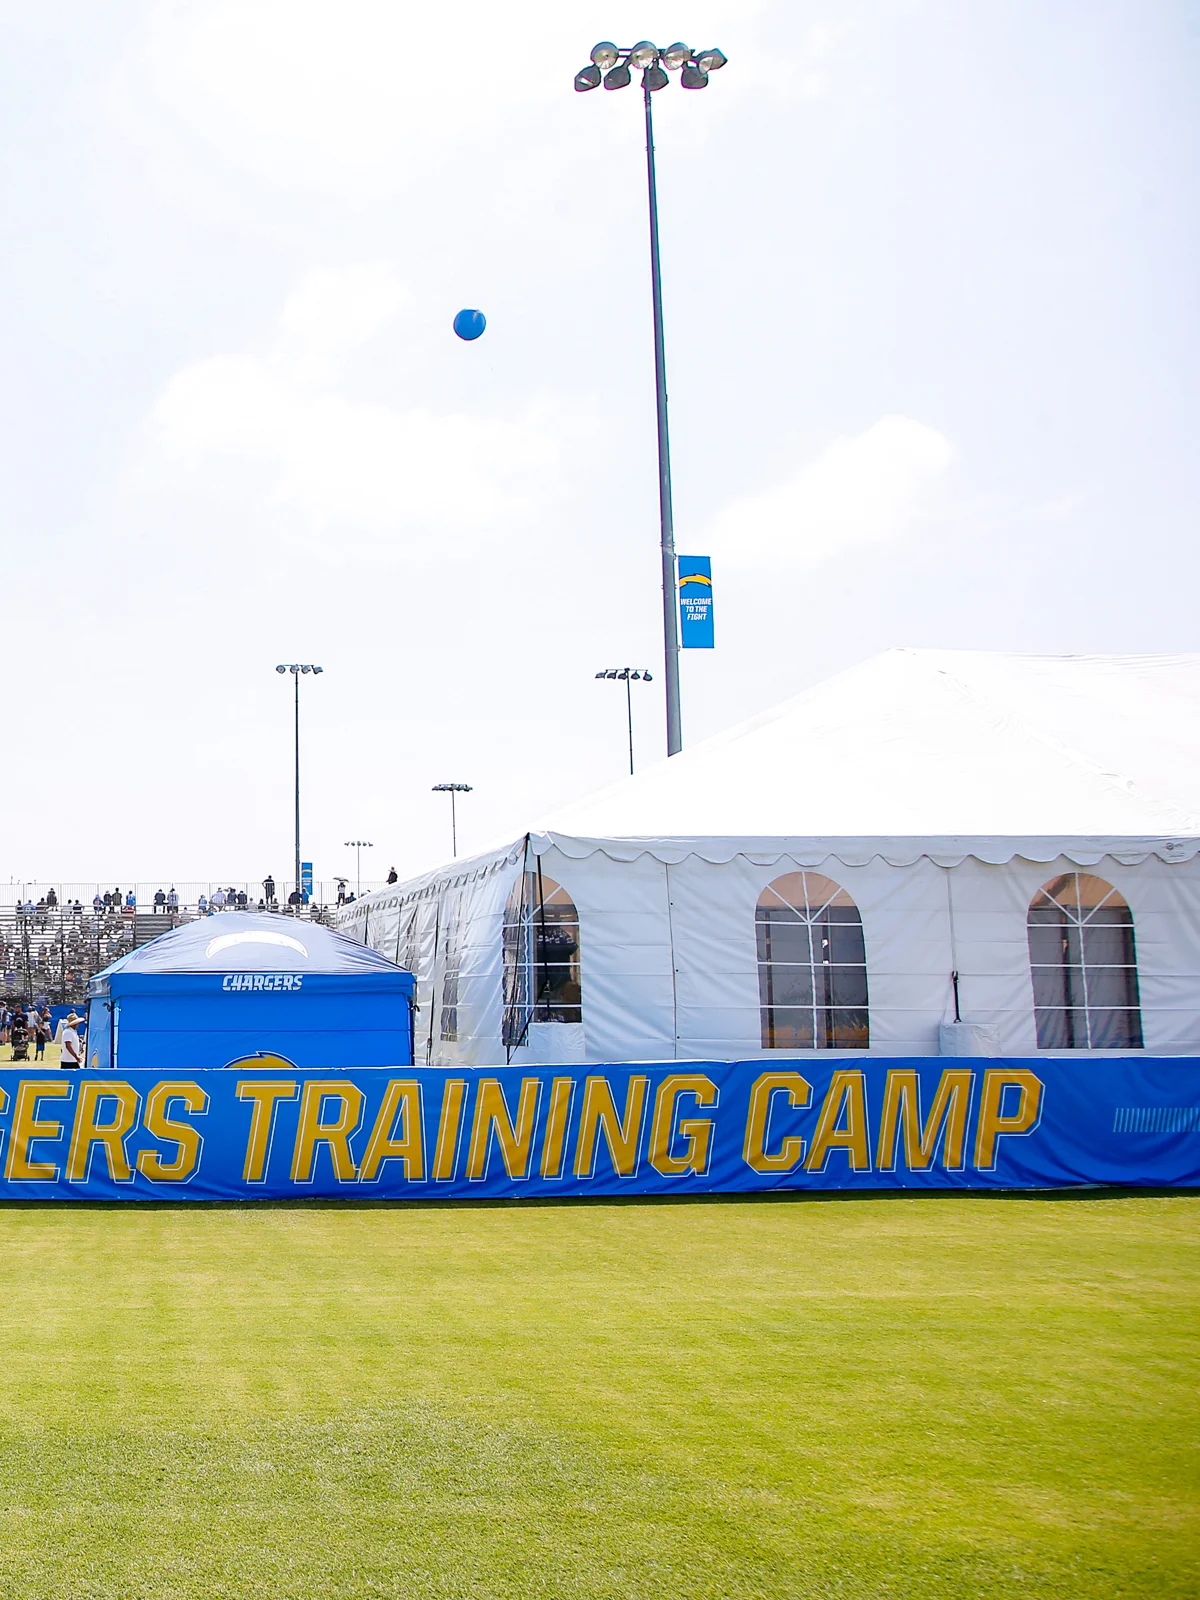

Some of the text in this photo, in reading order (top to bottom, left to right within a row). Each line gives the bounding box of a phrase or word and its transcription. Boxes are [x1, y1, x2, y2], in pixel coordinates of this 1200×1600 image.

[222, 975, 303, 991] CHARGERS
[235, 1073, 719, 1184] TRAINING
[742, 1068, 1044, 1175] CAMP
